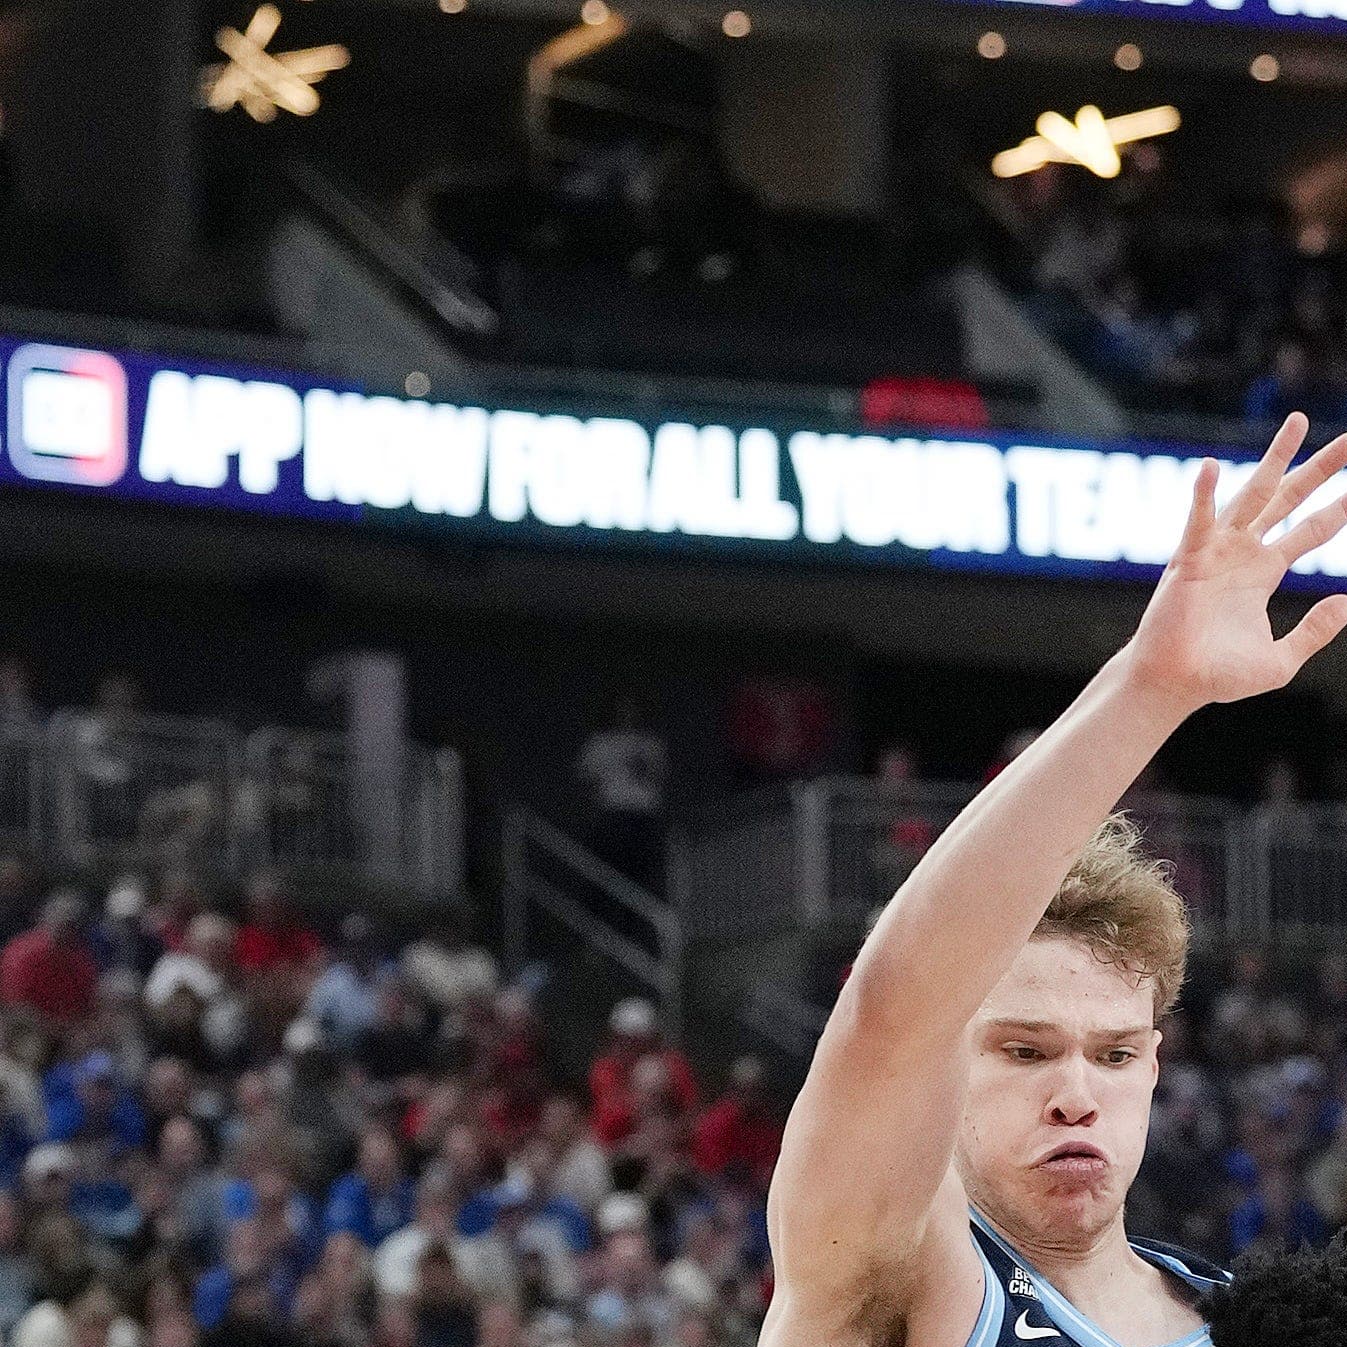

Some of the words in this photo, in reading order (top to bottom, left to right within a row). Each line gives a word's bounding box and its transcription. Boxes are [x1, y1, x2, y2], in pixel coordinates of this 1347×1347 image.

[140, 370, 302, 494] APP
[304, 389, 488, 517] NOW
[489, 410, 649, 527] FOR
[649, 422, 799, 541] ALL
[788, 431, 1006, 554] YOUR
